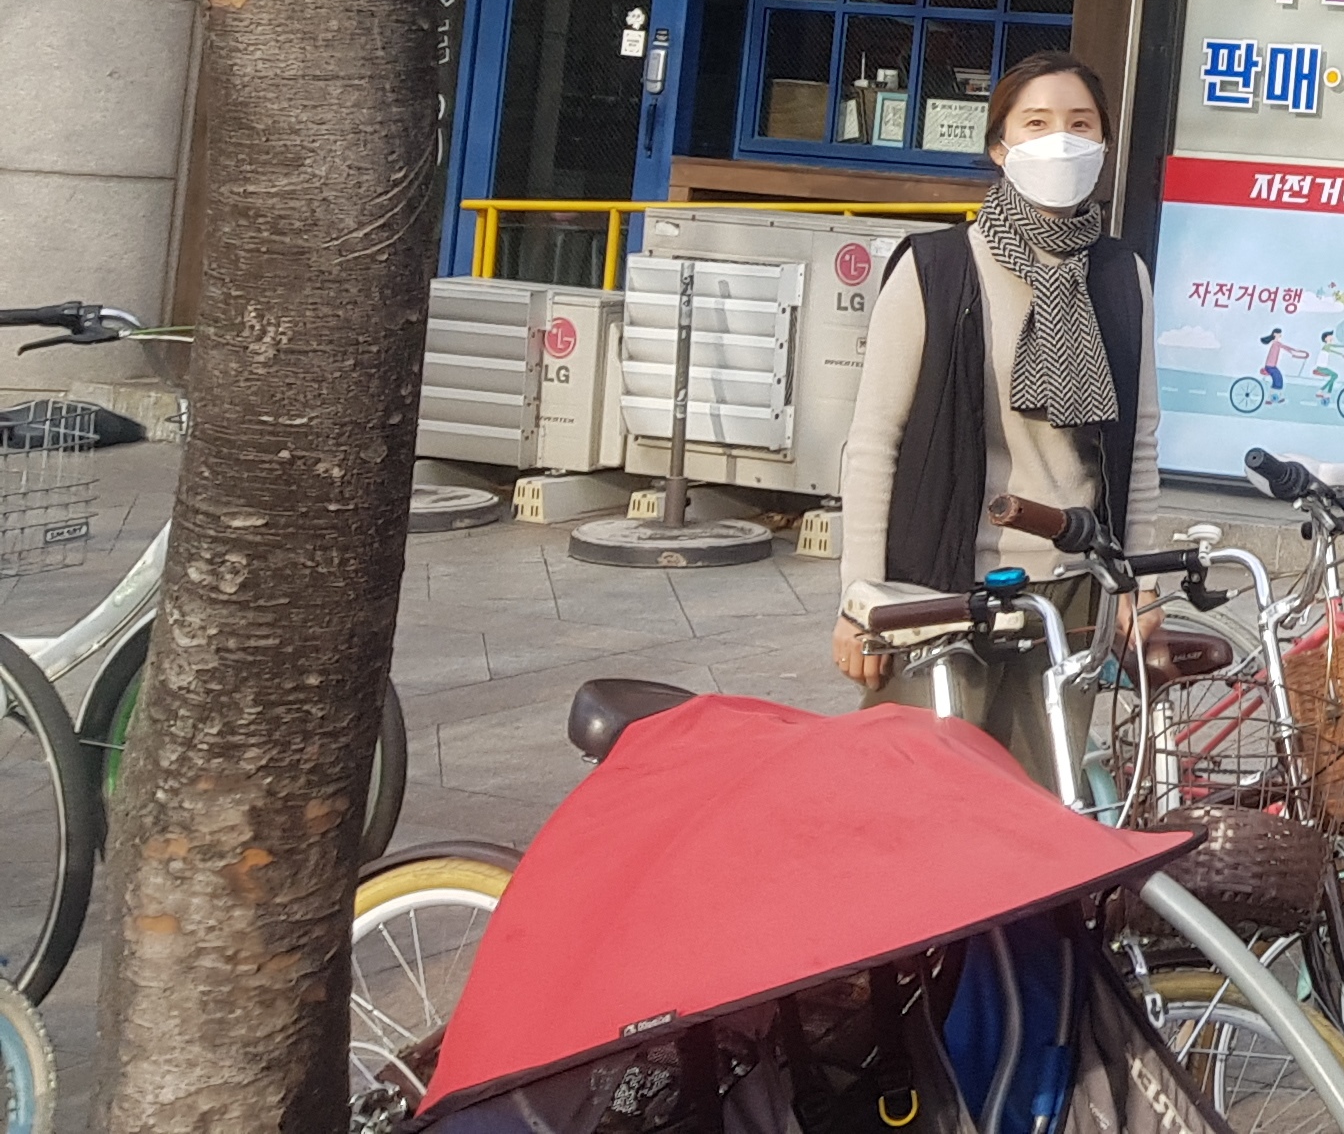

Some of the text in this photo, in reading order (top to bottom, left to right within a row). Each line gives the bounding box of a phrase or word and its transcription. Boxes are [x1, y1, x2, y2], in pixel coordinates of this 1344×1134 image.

[939, 123, 975, 139] LUCKY
[836, 292, 865, 313] LG
[1187, 279, 1304, 316] 자전거여행
[543, 364, 570, 384] LG
